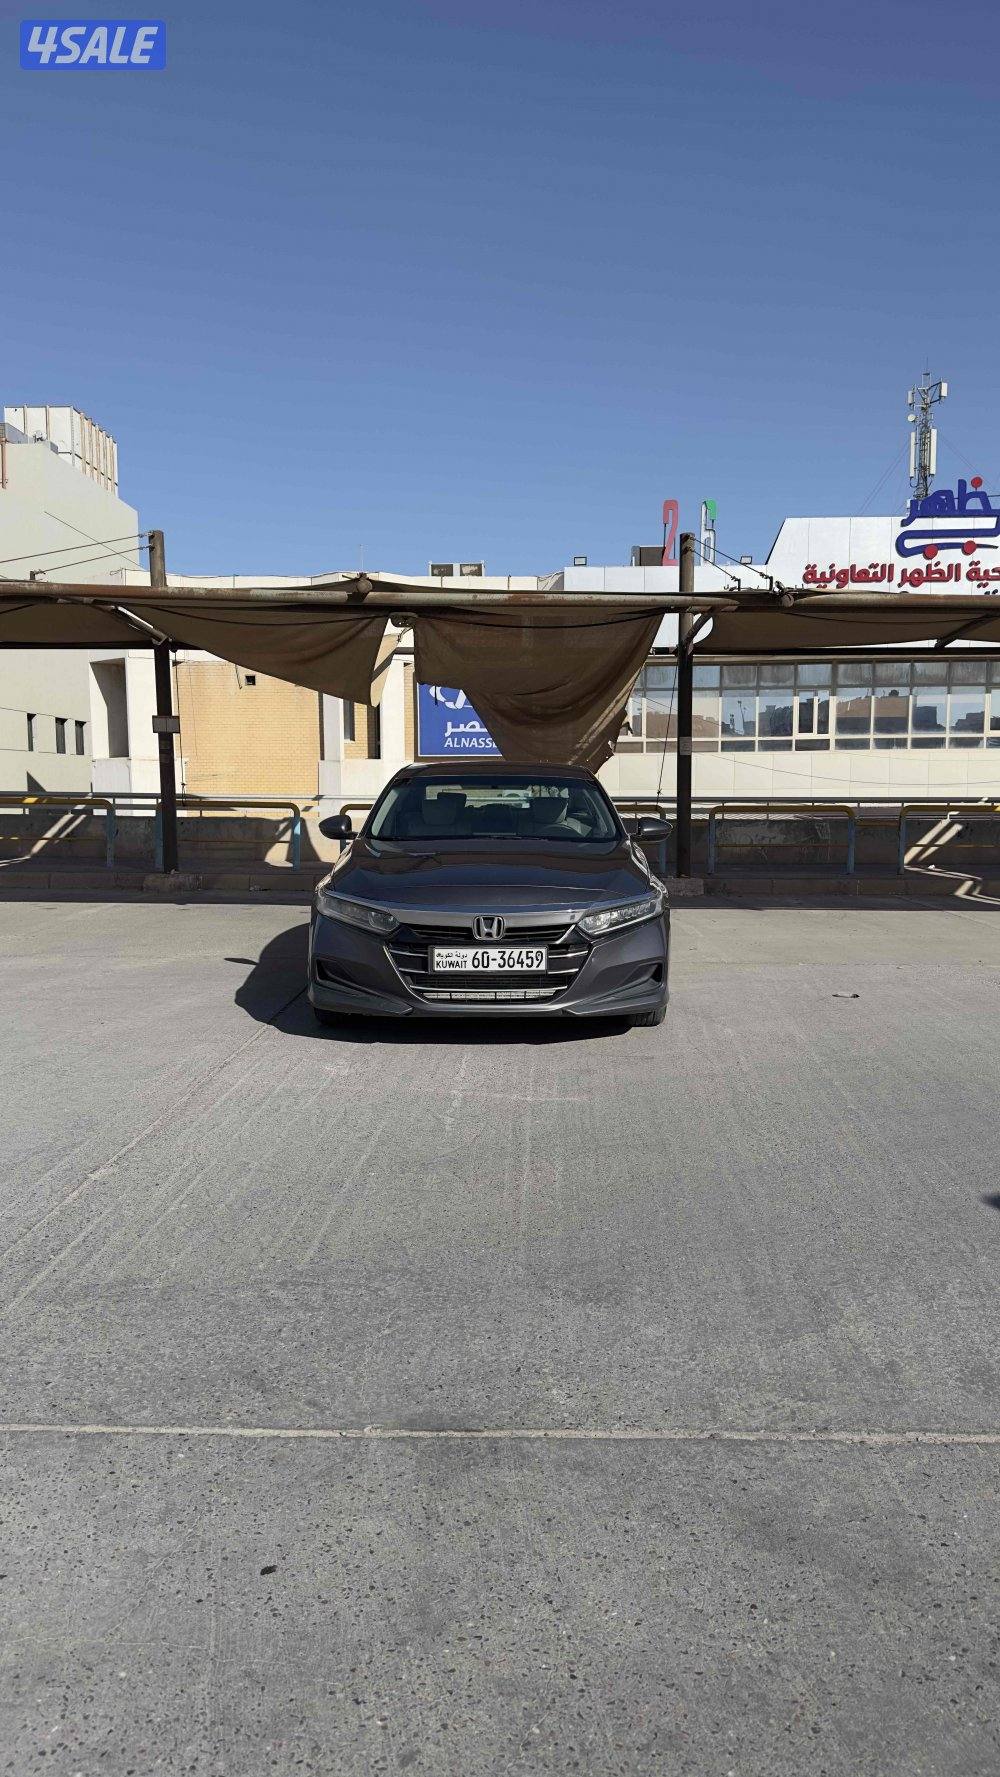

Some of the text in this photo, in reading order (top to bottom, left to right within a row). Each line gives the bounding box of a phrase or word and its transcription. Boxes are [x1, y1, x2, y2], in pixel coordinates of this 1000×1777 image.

[802, 562, 895, 589] التعاونية
[897, 561, 962, 588] الظهر
[436, 960, 467, 969] KUWAIT
[472, 950, 544, 969] 60-36459
